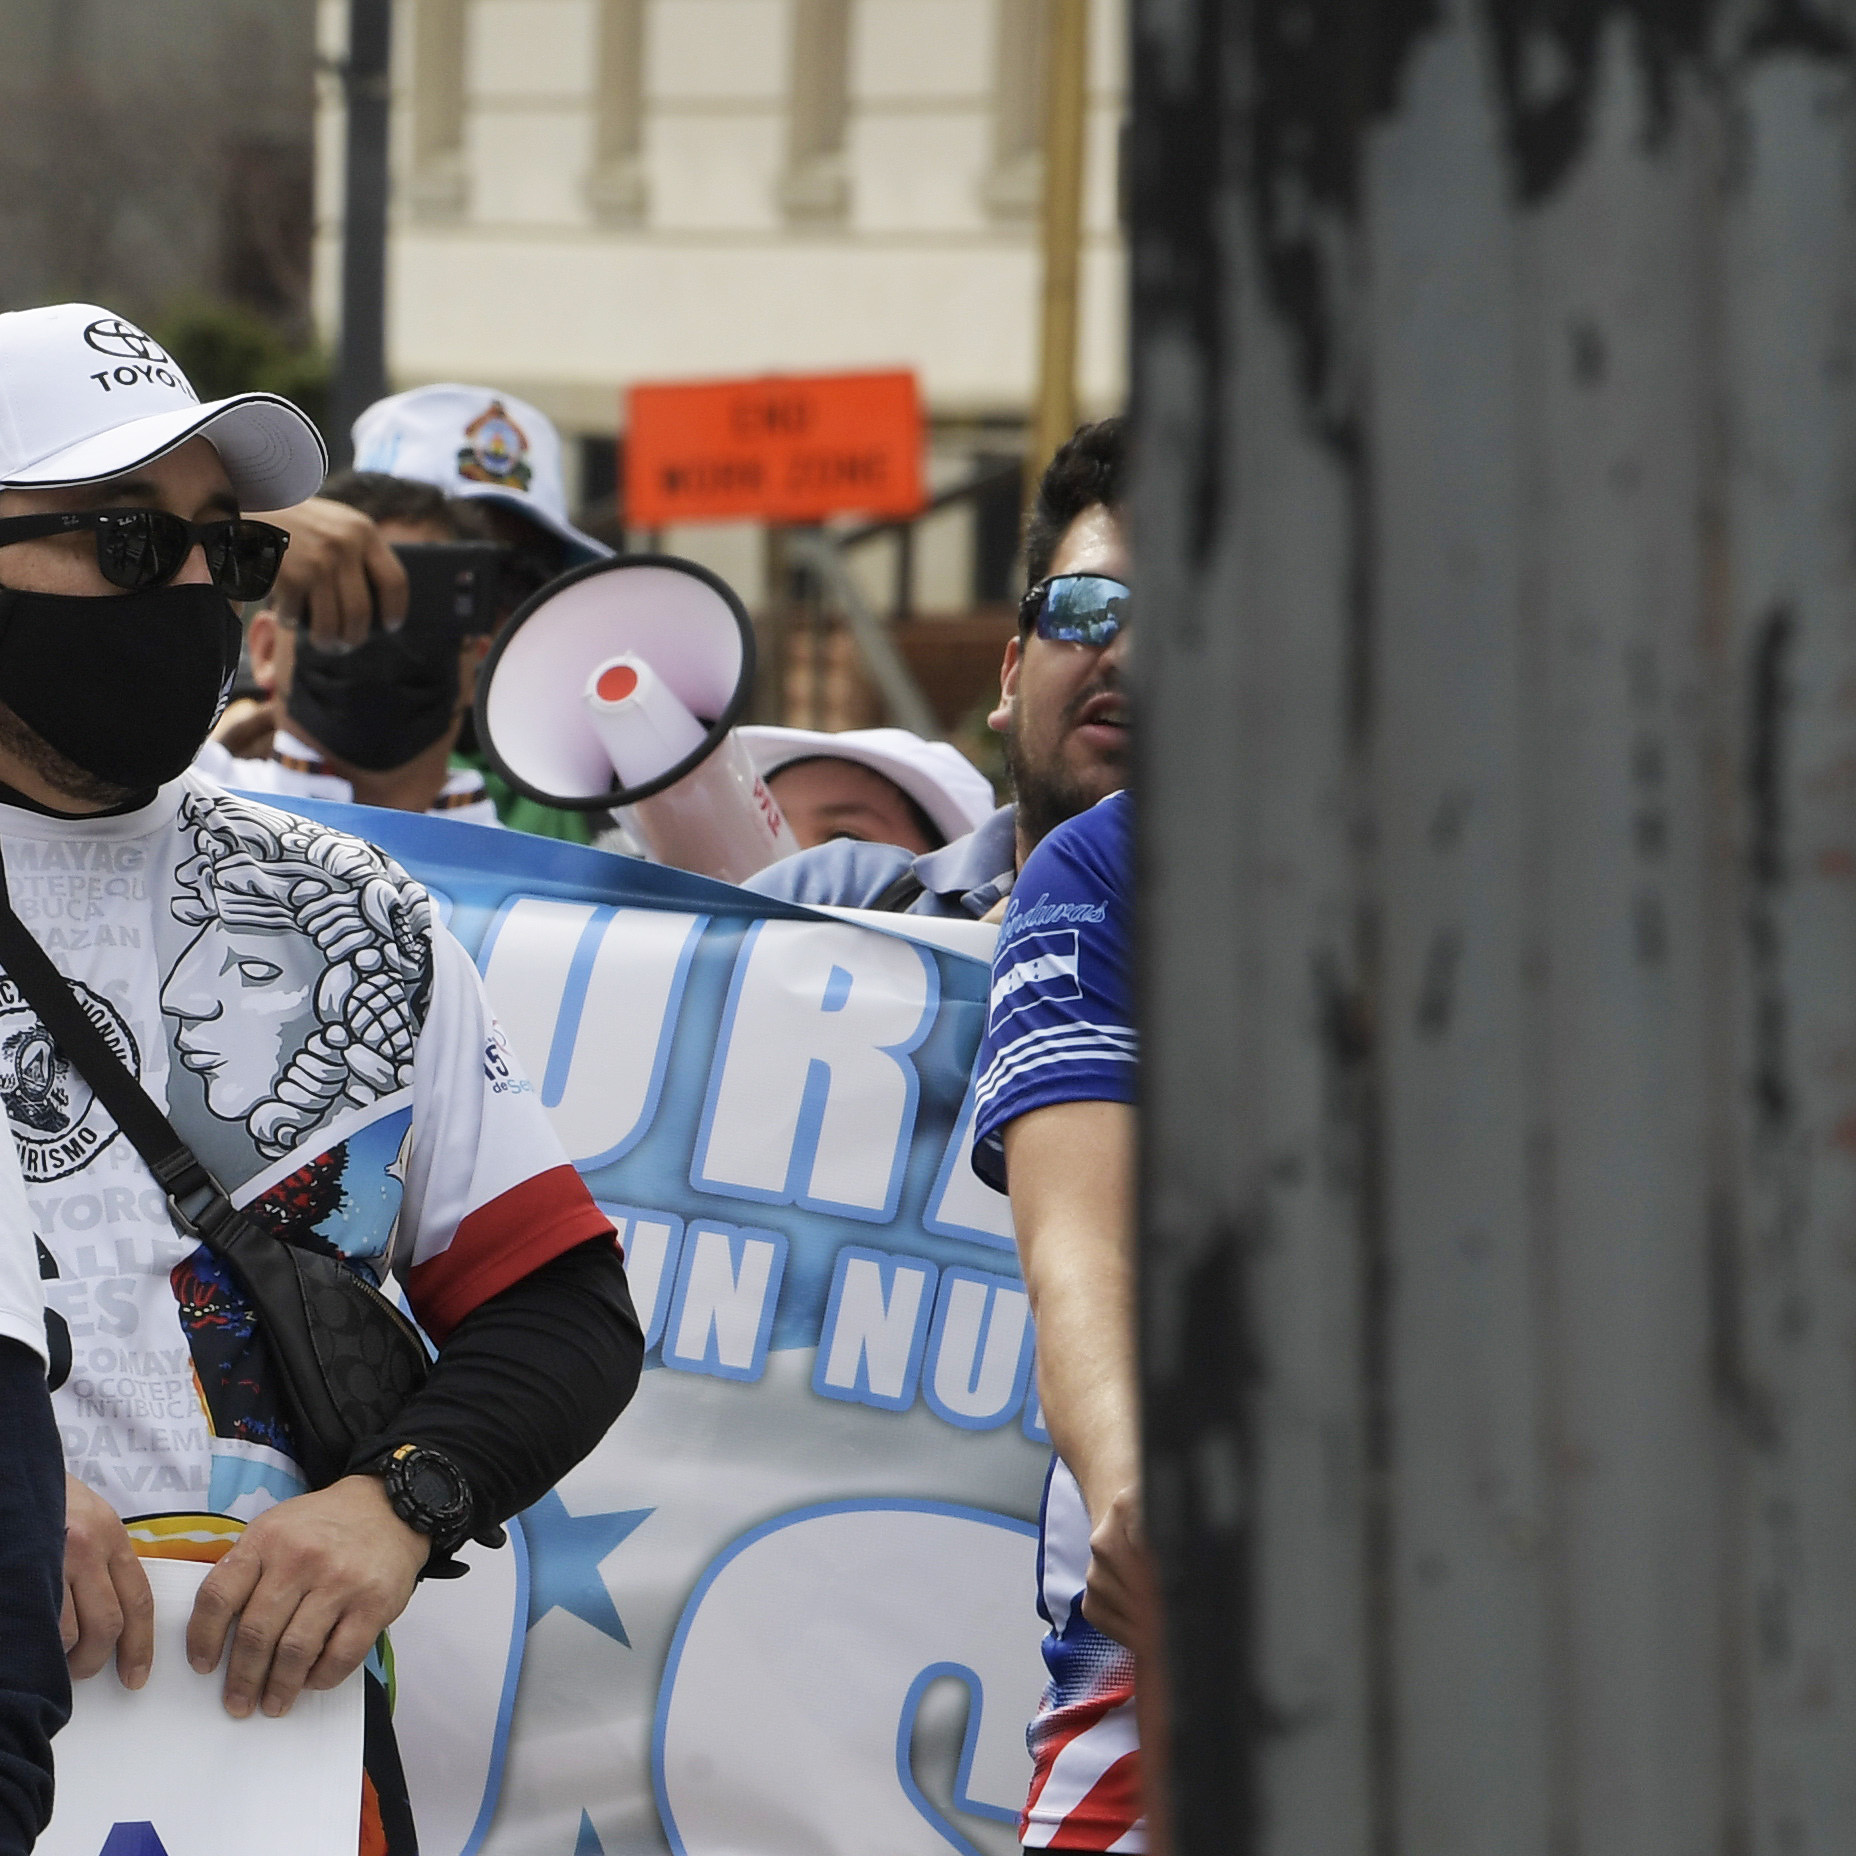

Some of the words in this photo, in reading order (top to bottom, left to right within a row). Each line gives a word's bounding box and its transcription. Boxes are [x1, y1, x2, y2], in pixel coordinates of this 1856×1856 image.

[90, 364, 197, 402] TOYOT
[822, 1245, 1050, 1435] NU
[73, 1377, 193, 1402] OCOTEP
